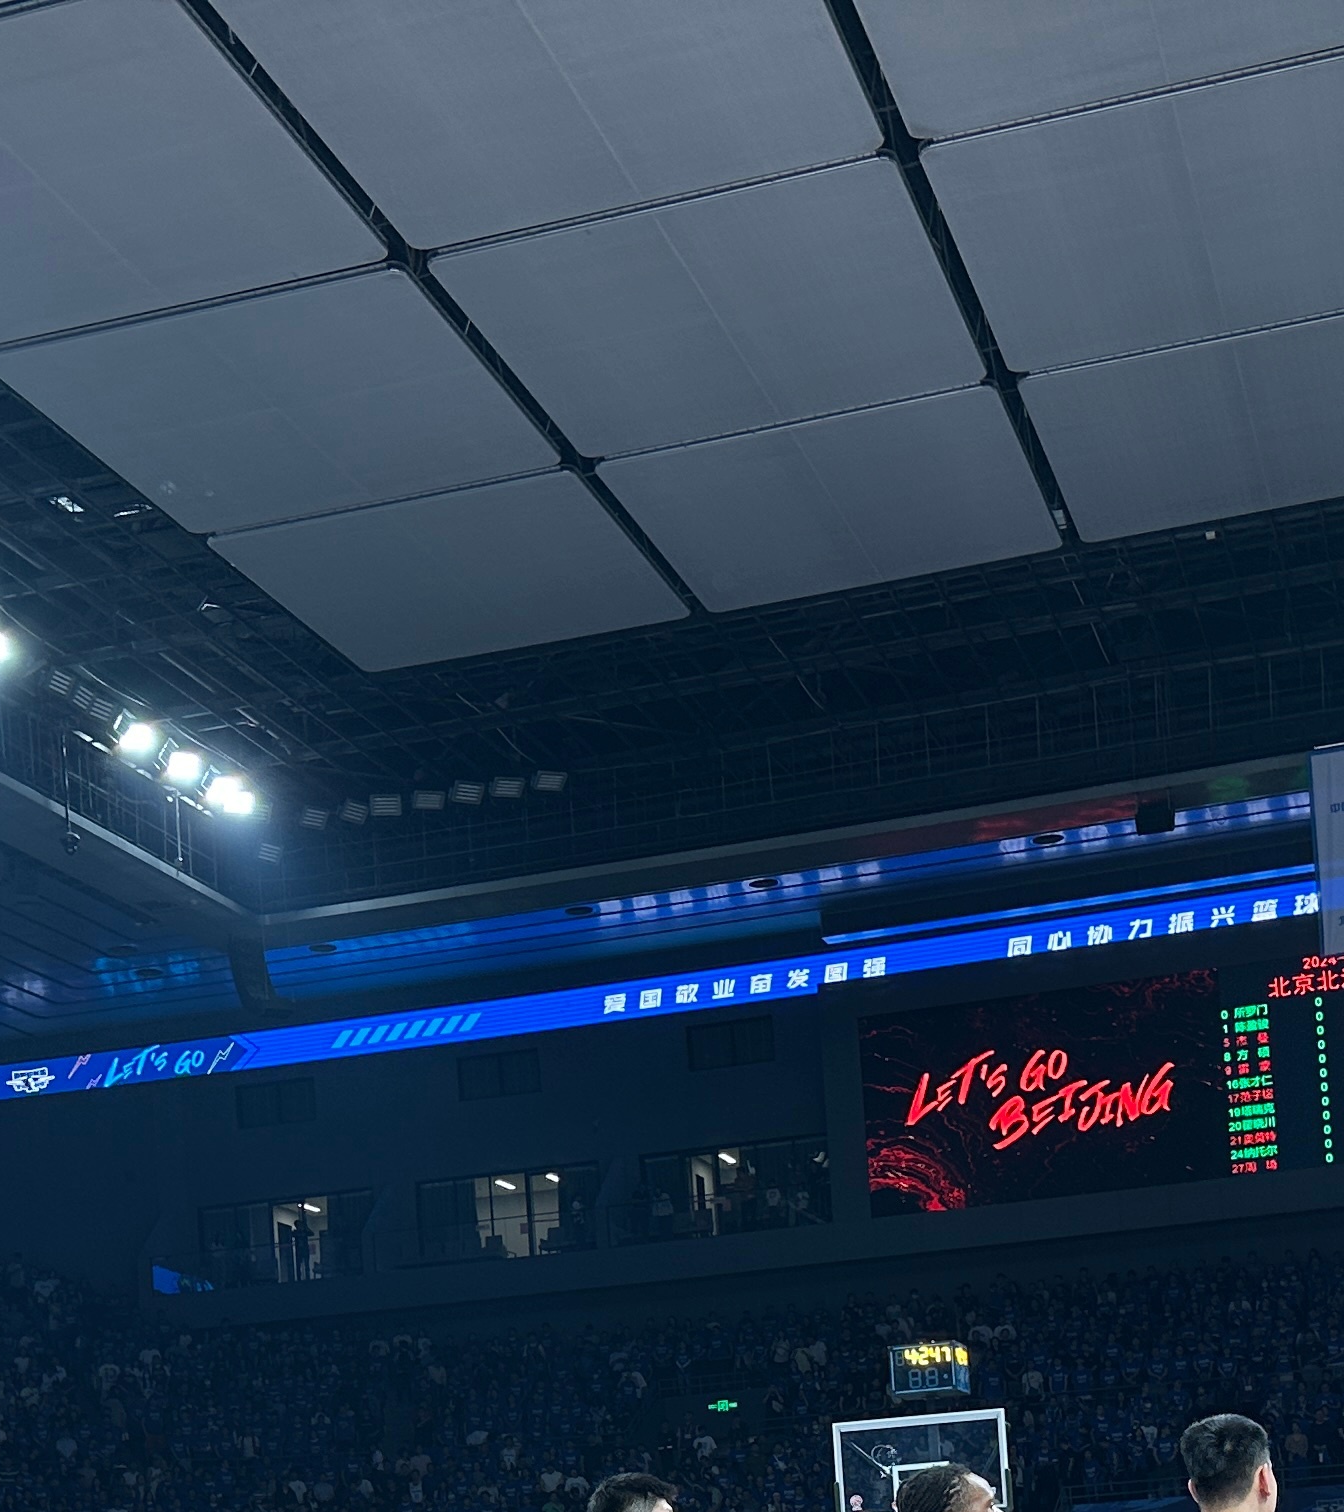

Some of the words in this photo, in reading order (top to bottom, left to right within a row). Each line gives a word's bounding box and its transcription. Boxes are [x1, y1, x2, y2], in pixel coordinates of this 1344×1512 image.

[1007, 892, 1320, 958] 同心协力振兴篮球
[604, 956, 886, 1014] 爱国敬业奋发图强
[1221, 1011, 1228, 1019] 0
[1315, 997, 1322, 1006] 0
[1223, 1025, 1228, 1033] 1
[1316, 1012, 1323, 1021] 0
[1223, 1038, 1230, 1047] 5
[1317, 1026, 1324, 1035] 0
[1224, 1052, 1230, 1061] 8
[1318, 1040, 1325, 1049] 0
[103, 1045, 168, 1088] LET'S
[175, 1050, 205, 1075] GO
[1225, 1066, 1232, 1075] 9
[1319, 1054, 1326, 1063] 0
[1319, 1068, 1327, 1077] 0
[905, 1050, 1007, 1127] LET'S
[1020, 1050, 1068, 1091] GO
[1321, 1082, 1328, 1091] 0
[989, 1062, 1175, 1150] BEIJING
[1322, 1097, 1329, 1106] 0
[1323, 1111, 1330, 1120] 0
[1324, 1125, 1331, 1134] 0
[1325, 1139, 1332, 1148] 0
[1326, 1153, 1333, 1163] 0
